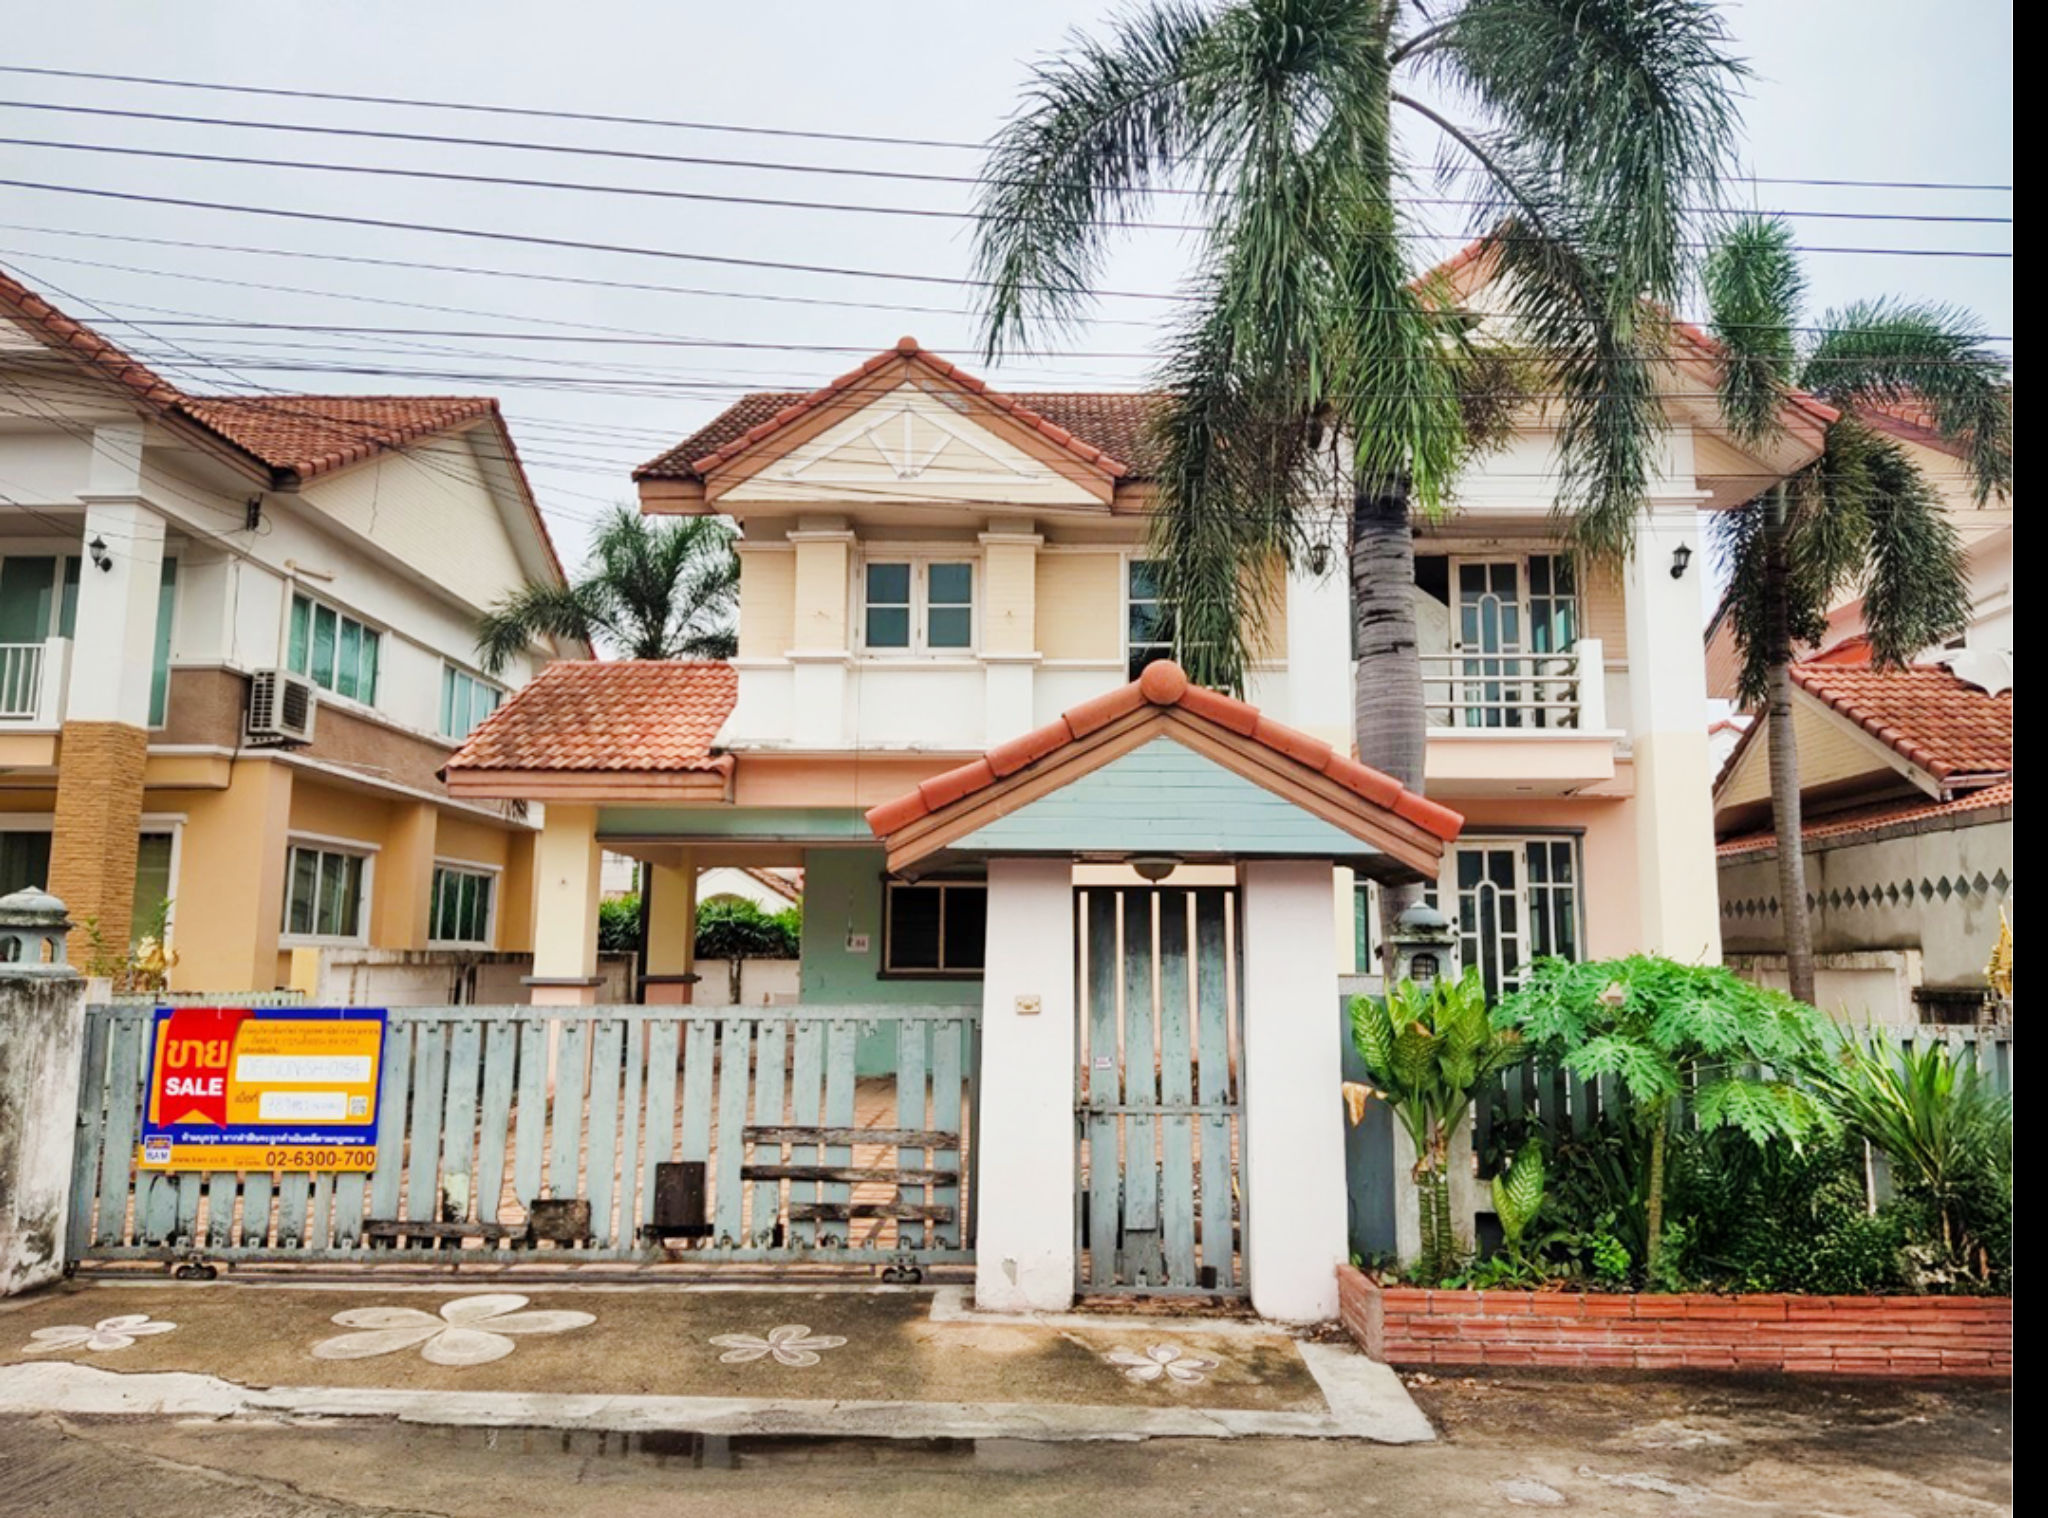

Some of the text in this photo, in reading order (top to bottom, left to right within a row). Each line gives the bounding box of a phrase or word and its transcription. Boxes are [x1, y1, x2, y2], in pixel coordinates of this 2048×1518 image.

[167, 1040, 228, 1067] ขาย
[165, 1077, 223, 1096] SALE
[265, 1151, 375, 1166] 02-6300-700
